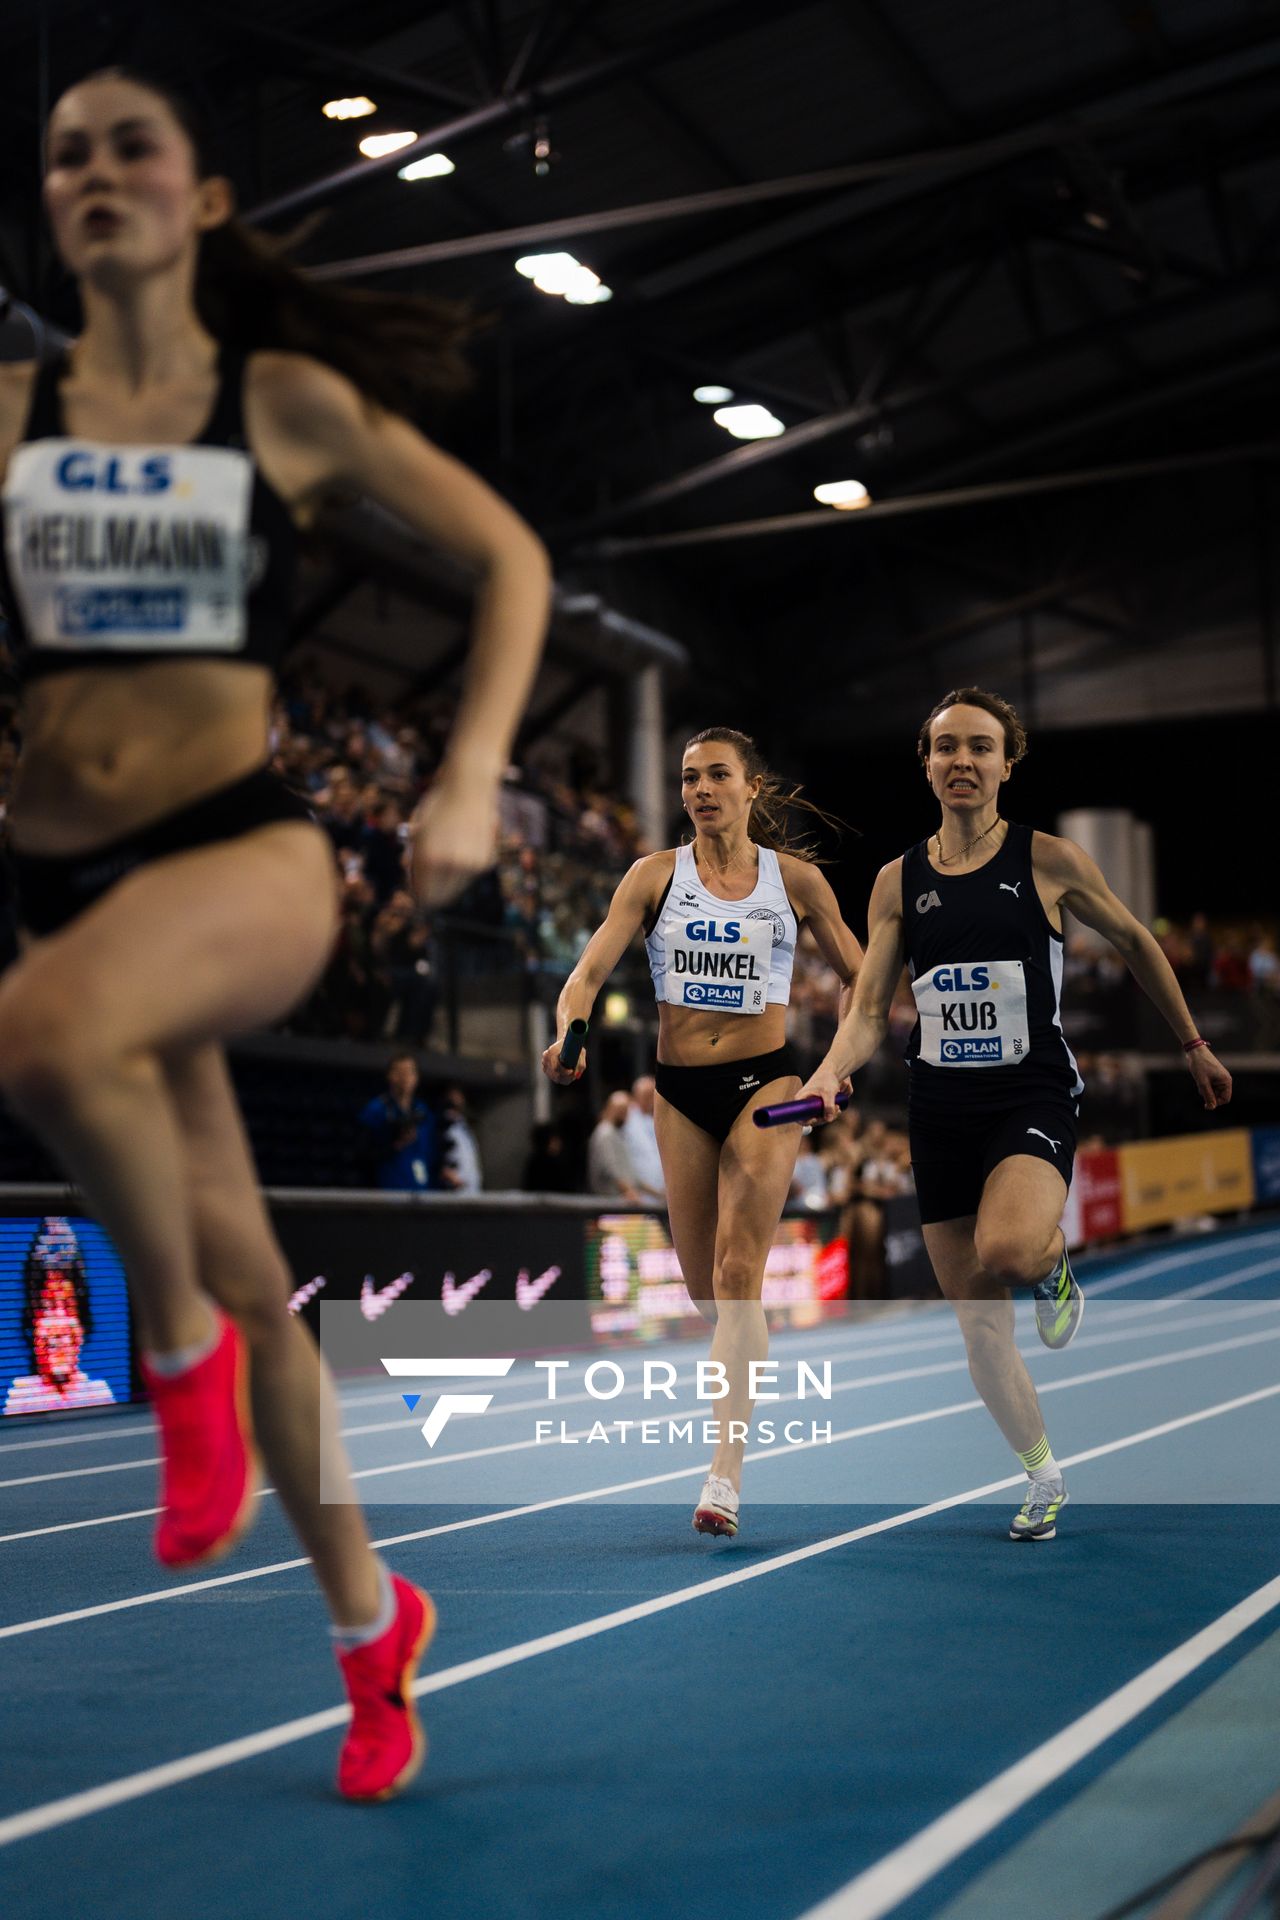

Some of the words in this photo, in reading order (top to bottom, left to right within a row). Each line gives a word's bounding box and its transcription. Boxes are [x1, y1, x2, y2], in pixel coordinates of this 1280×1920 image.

[20, 512, 227, 573] HEILMANN
[679, 900, 699, 908] erima
[674, 949, 760, 981] DUNKEL
[707, 988, 741, 1000] PLAN
[752, 990, 762, 1006] 292
[963, 1042, 999, 1053] PLAN
[1013, 1038, 1023, 1055] 286
[739, 1080, 760, 1090] erima
